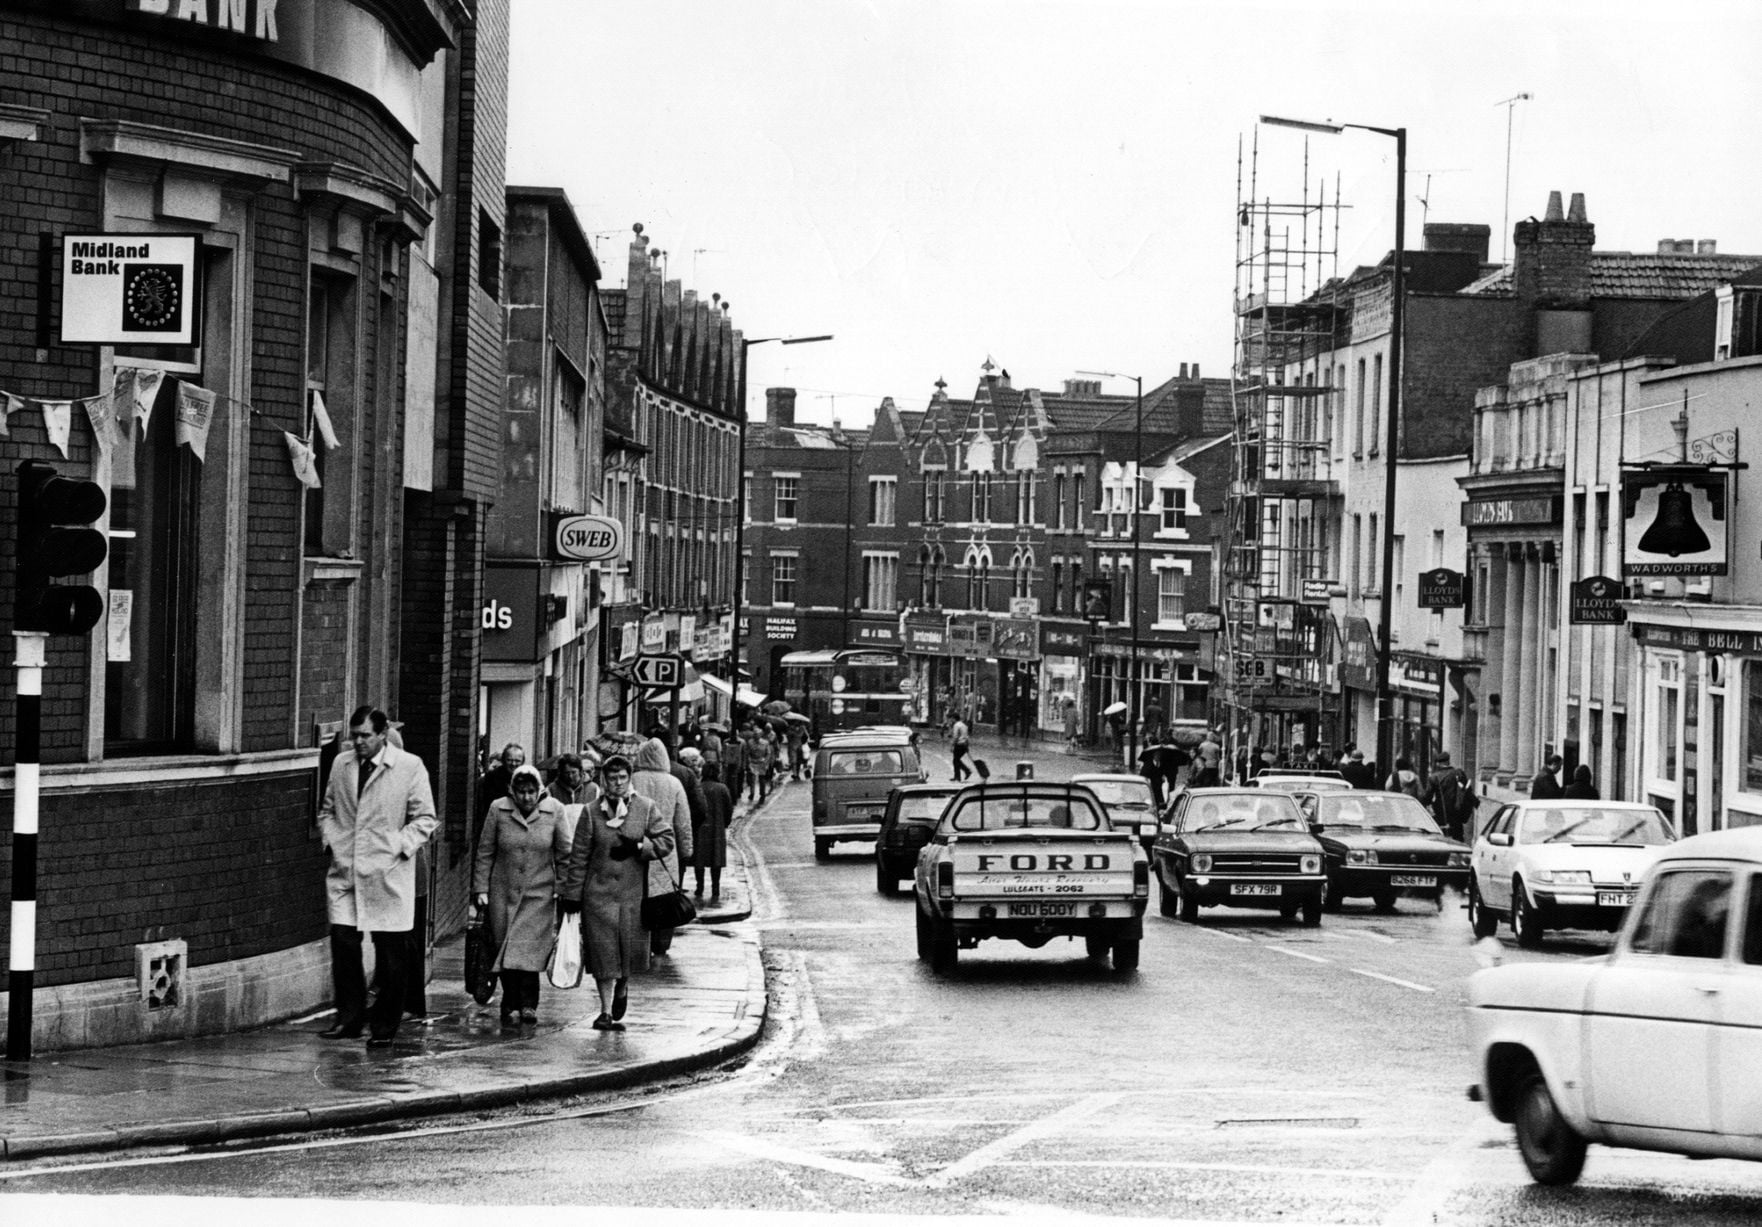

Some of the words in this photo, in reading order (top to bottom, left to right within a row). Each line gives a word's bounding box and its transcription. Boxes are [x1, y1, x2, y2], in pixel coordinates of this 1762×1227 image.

[139, 0, 279, 42] BANK
[71, 242, 150, 258] Midland
[71, 259, 120, 275] Bank
[565, 529, 612, 548] SWEB
[1631, 563, 1718, 573] WADWORTHS
[1304, 582, 1326, 590] Radio
[1428, 595, 1455, 604] BANK
[1582, 609, 1614, 620] BANK
[766, 617, 796, 625] HALIFAX
[767, 632, 795, 640] SOCIETY
[1682, 631, 1700, 646] THE
[1708, 633, 1743, 650] BELL
[660, 663, 671, 680] P
[977, 854, 1110, 871] FORD
[1055, 885, 1084, 893] 2062
[1235, 885, 1256, 895] SFX
[1258, 885, 1277, 895] 79R
[1600, 894, 1623, 904] FHT
[1010, 904, 1038, 916] NOU
[1039, 904, 1076, 916] 600Y
